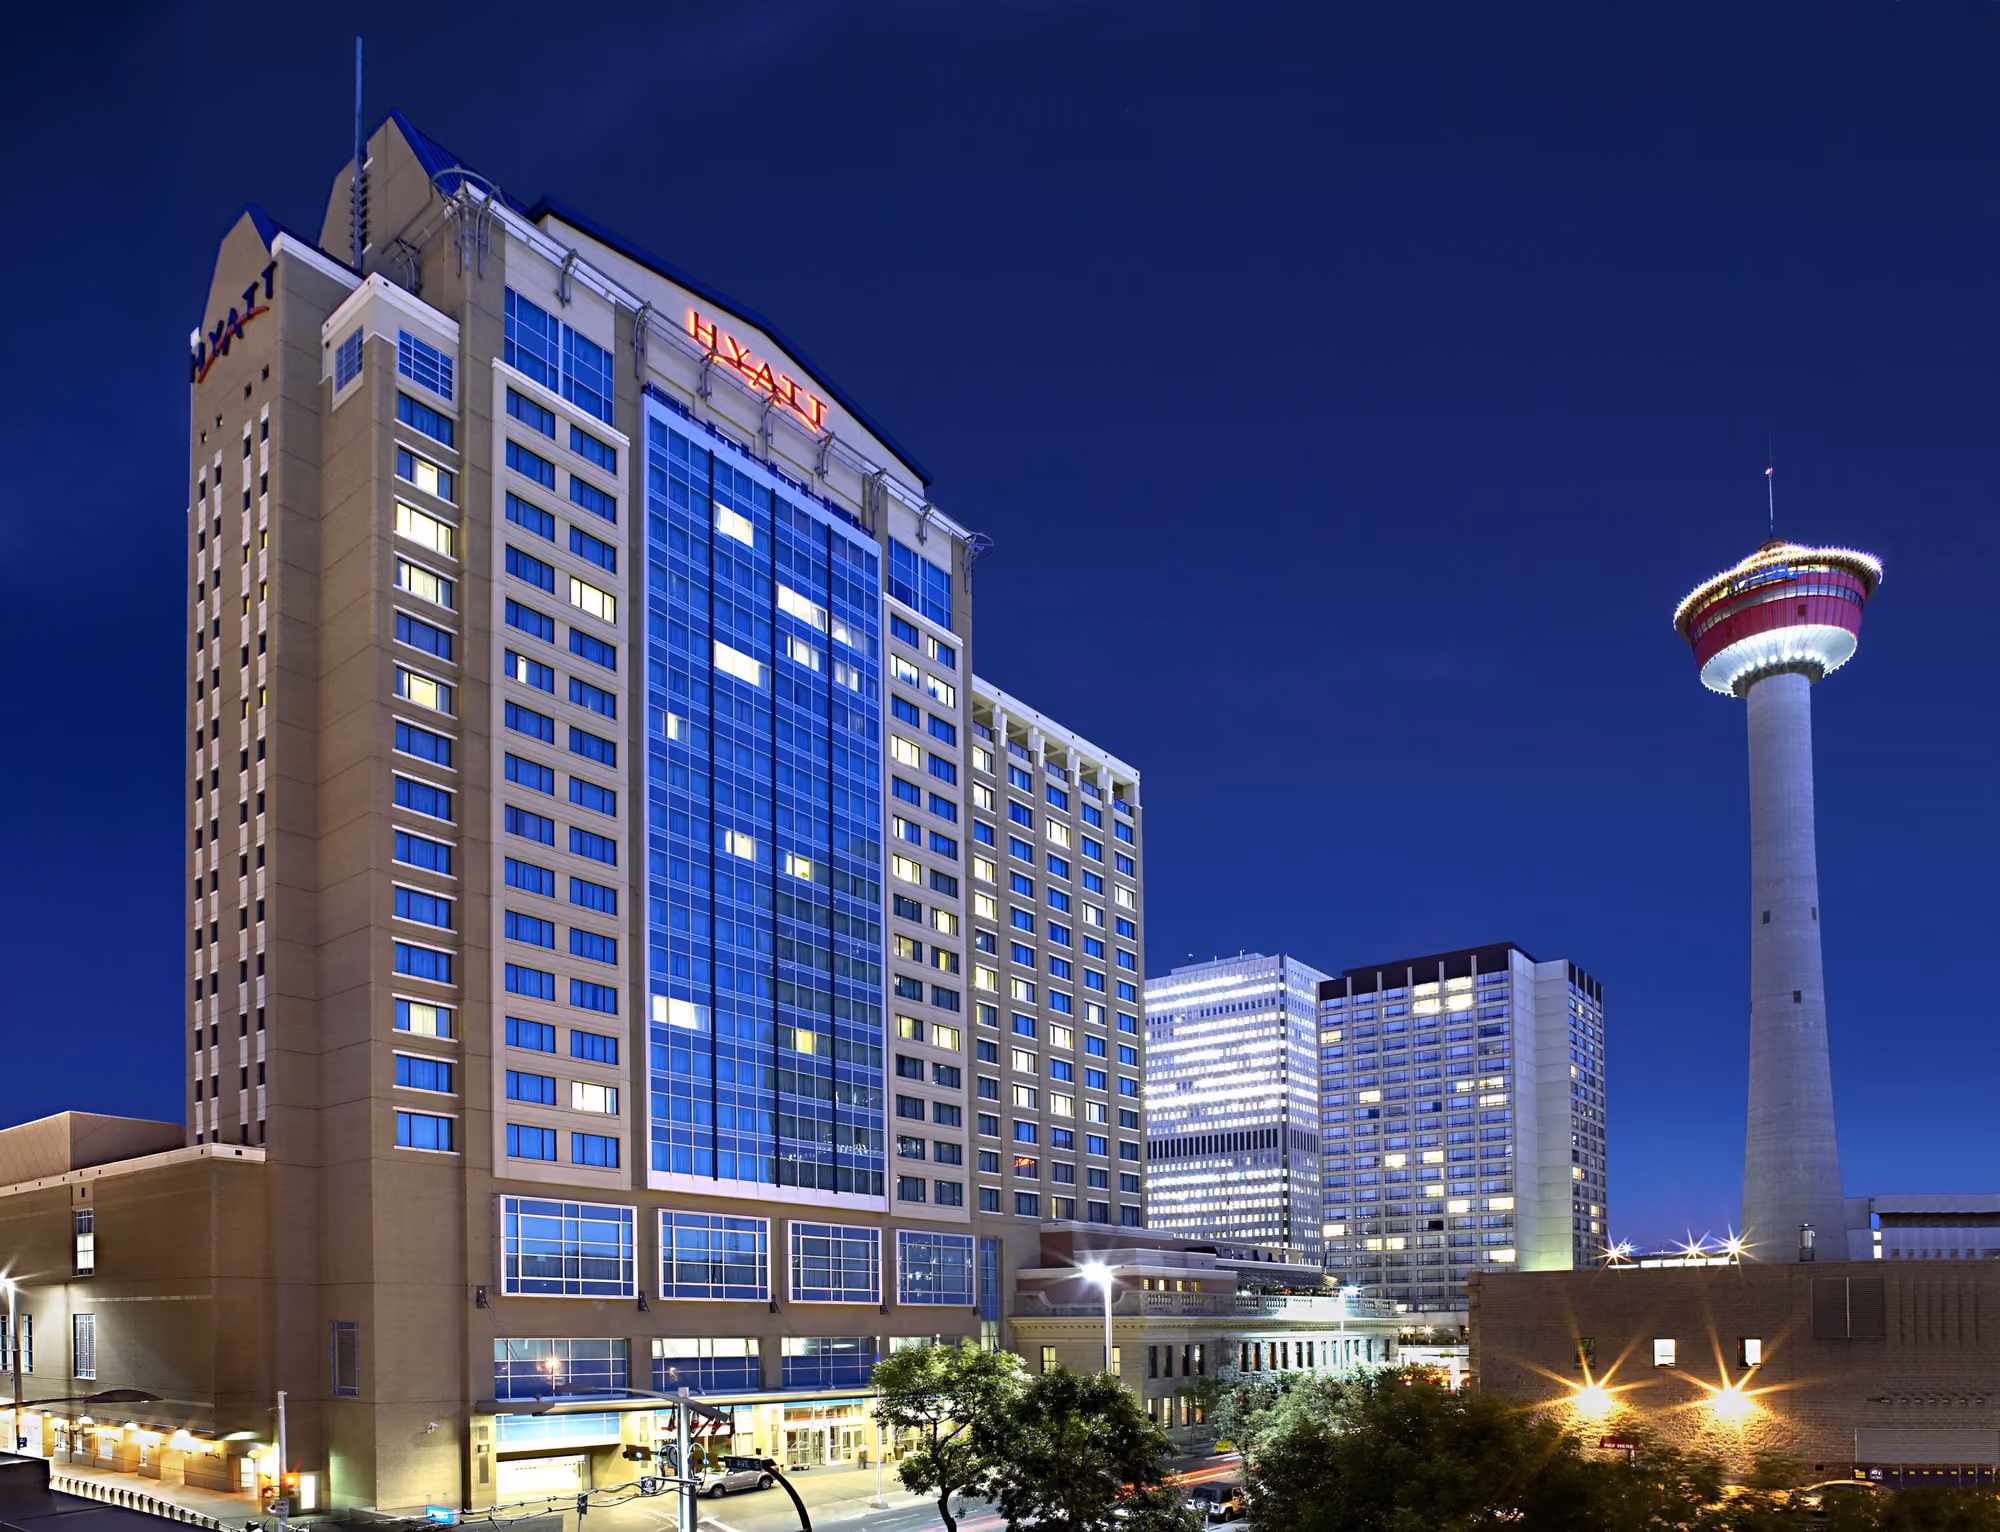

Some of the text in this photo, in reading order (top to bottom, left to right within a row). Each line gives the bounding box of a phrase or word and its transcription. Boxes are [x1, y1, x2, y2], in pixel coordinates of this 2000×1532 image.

[190, 261, 279, 384] HYATT
[687, 310, 828, 427] HYATT
[736, 1459, 750, 1469] AVE
